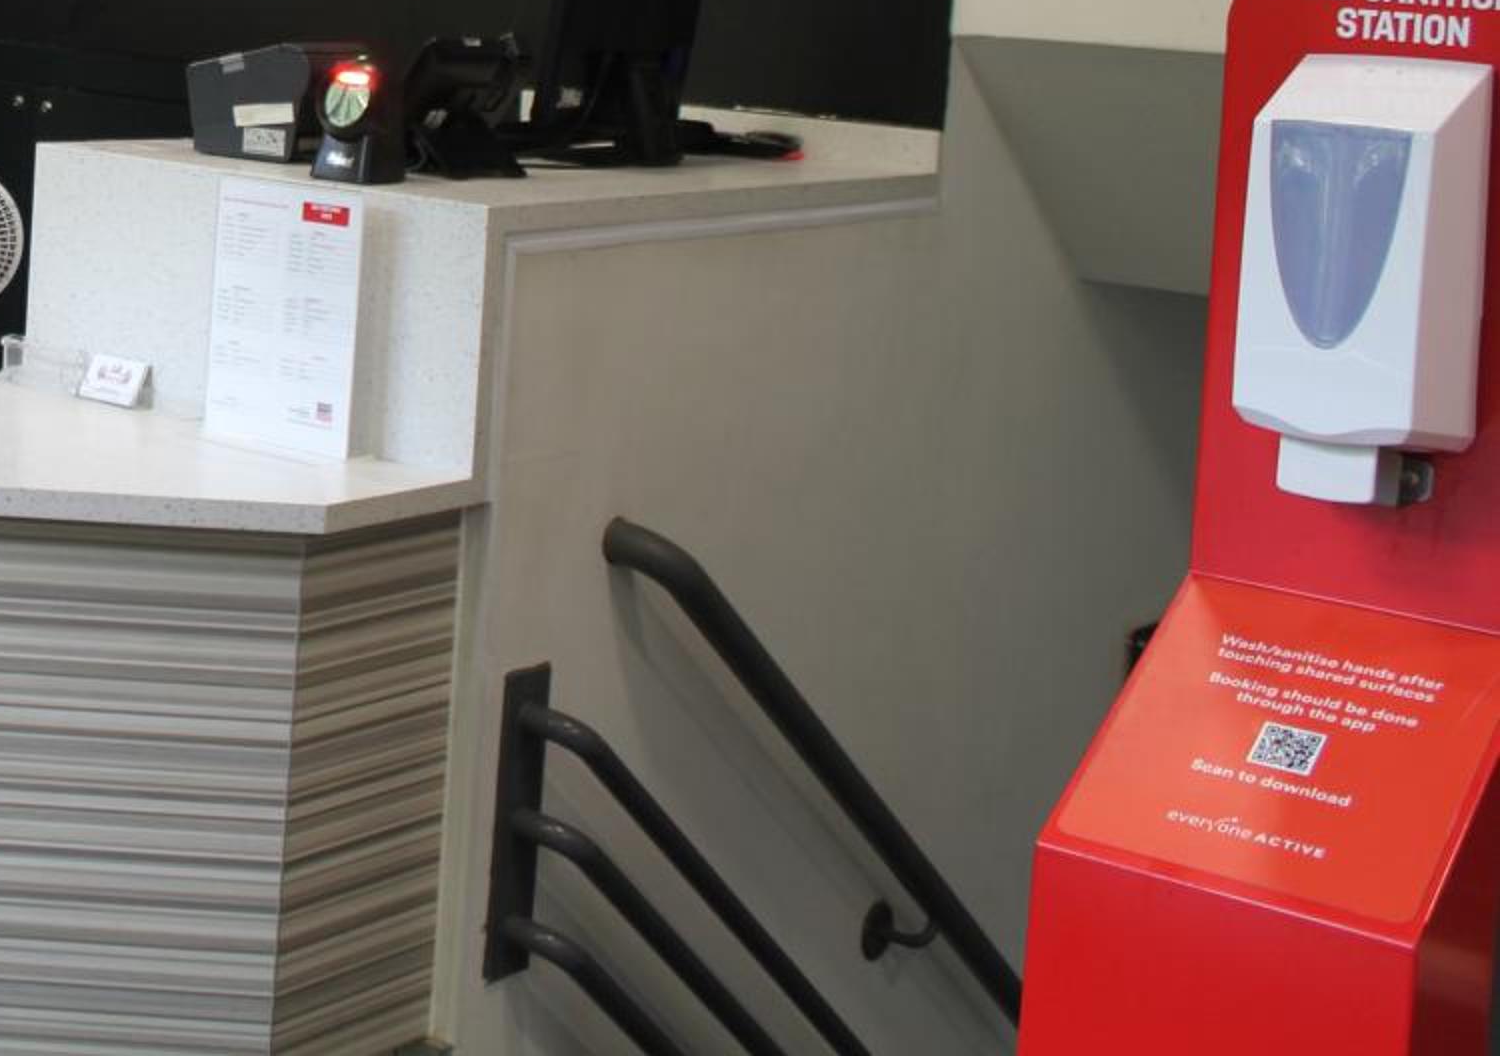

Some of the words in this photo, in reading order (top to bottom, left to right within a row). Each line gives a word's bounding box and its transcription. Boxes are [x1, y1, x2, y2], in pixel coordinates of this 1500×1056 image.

[1336, 7, 1471, 48] STATION
[1218, 647, 1292, 674] touching
[1295, 664, 1355, 687] shared
[1358, 677, 1436, 704] surfaces
[1221, 633, 1339, 670] Wash/sanitise
[1342, 660, 1396, 681] hands
[1399, 671, 1445, 692] after
[1209, 671, 1279, 698] Booking
[1281, 689, 1342, 711] should
[1344, 701, 1368, 717] be
[1371, 708, 1419, 729] done
[1236, 692, 1305, 717] through
[1308, 707, 1338, 724] the
[1341, 718, 1376, 734] app
[1190, 757, 1235, 780] Scan
[1238, 770, 1257, 784] to
[1260, 776, 1352, 808] download
[1166, 809, 1253, 839] everyone
[1254, 832, 1327, 859] ACTIVE
